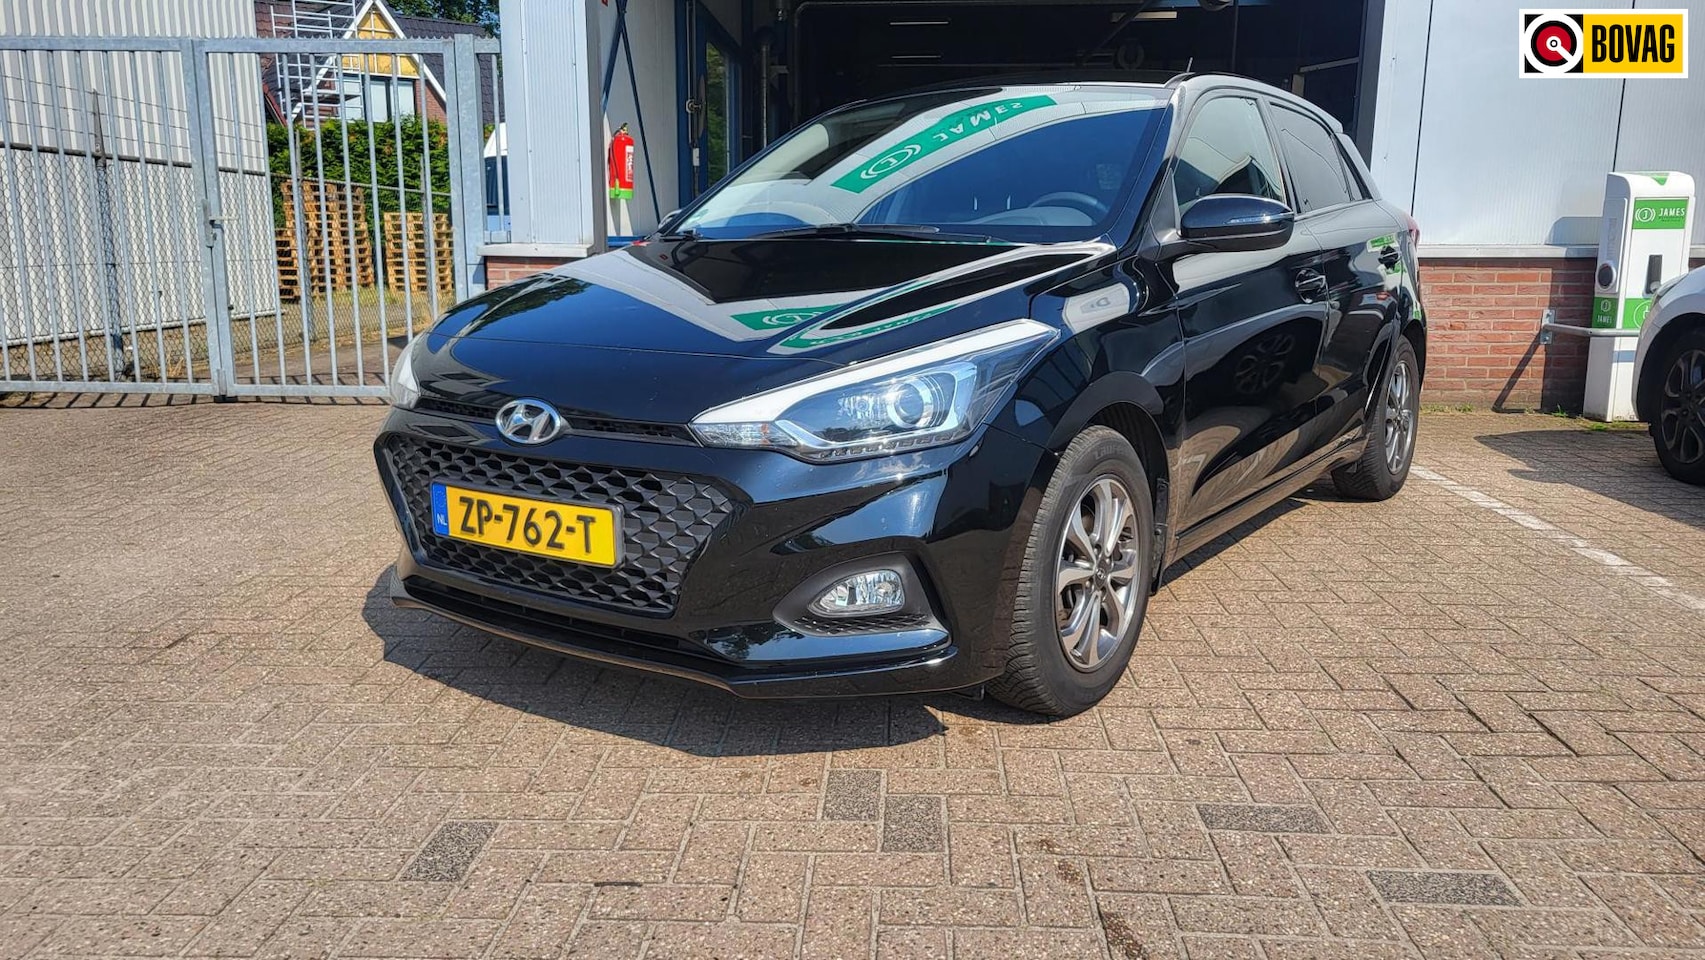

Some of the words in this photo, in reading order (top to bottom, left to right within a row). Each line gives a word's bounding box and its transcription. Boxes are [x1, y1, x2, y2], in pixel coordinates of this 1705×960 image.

[1658, 207, 1685, 217] JAMES
[436, 513, 447, 526] NL
[459, 496, 596, 554] ZP-762-T
